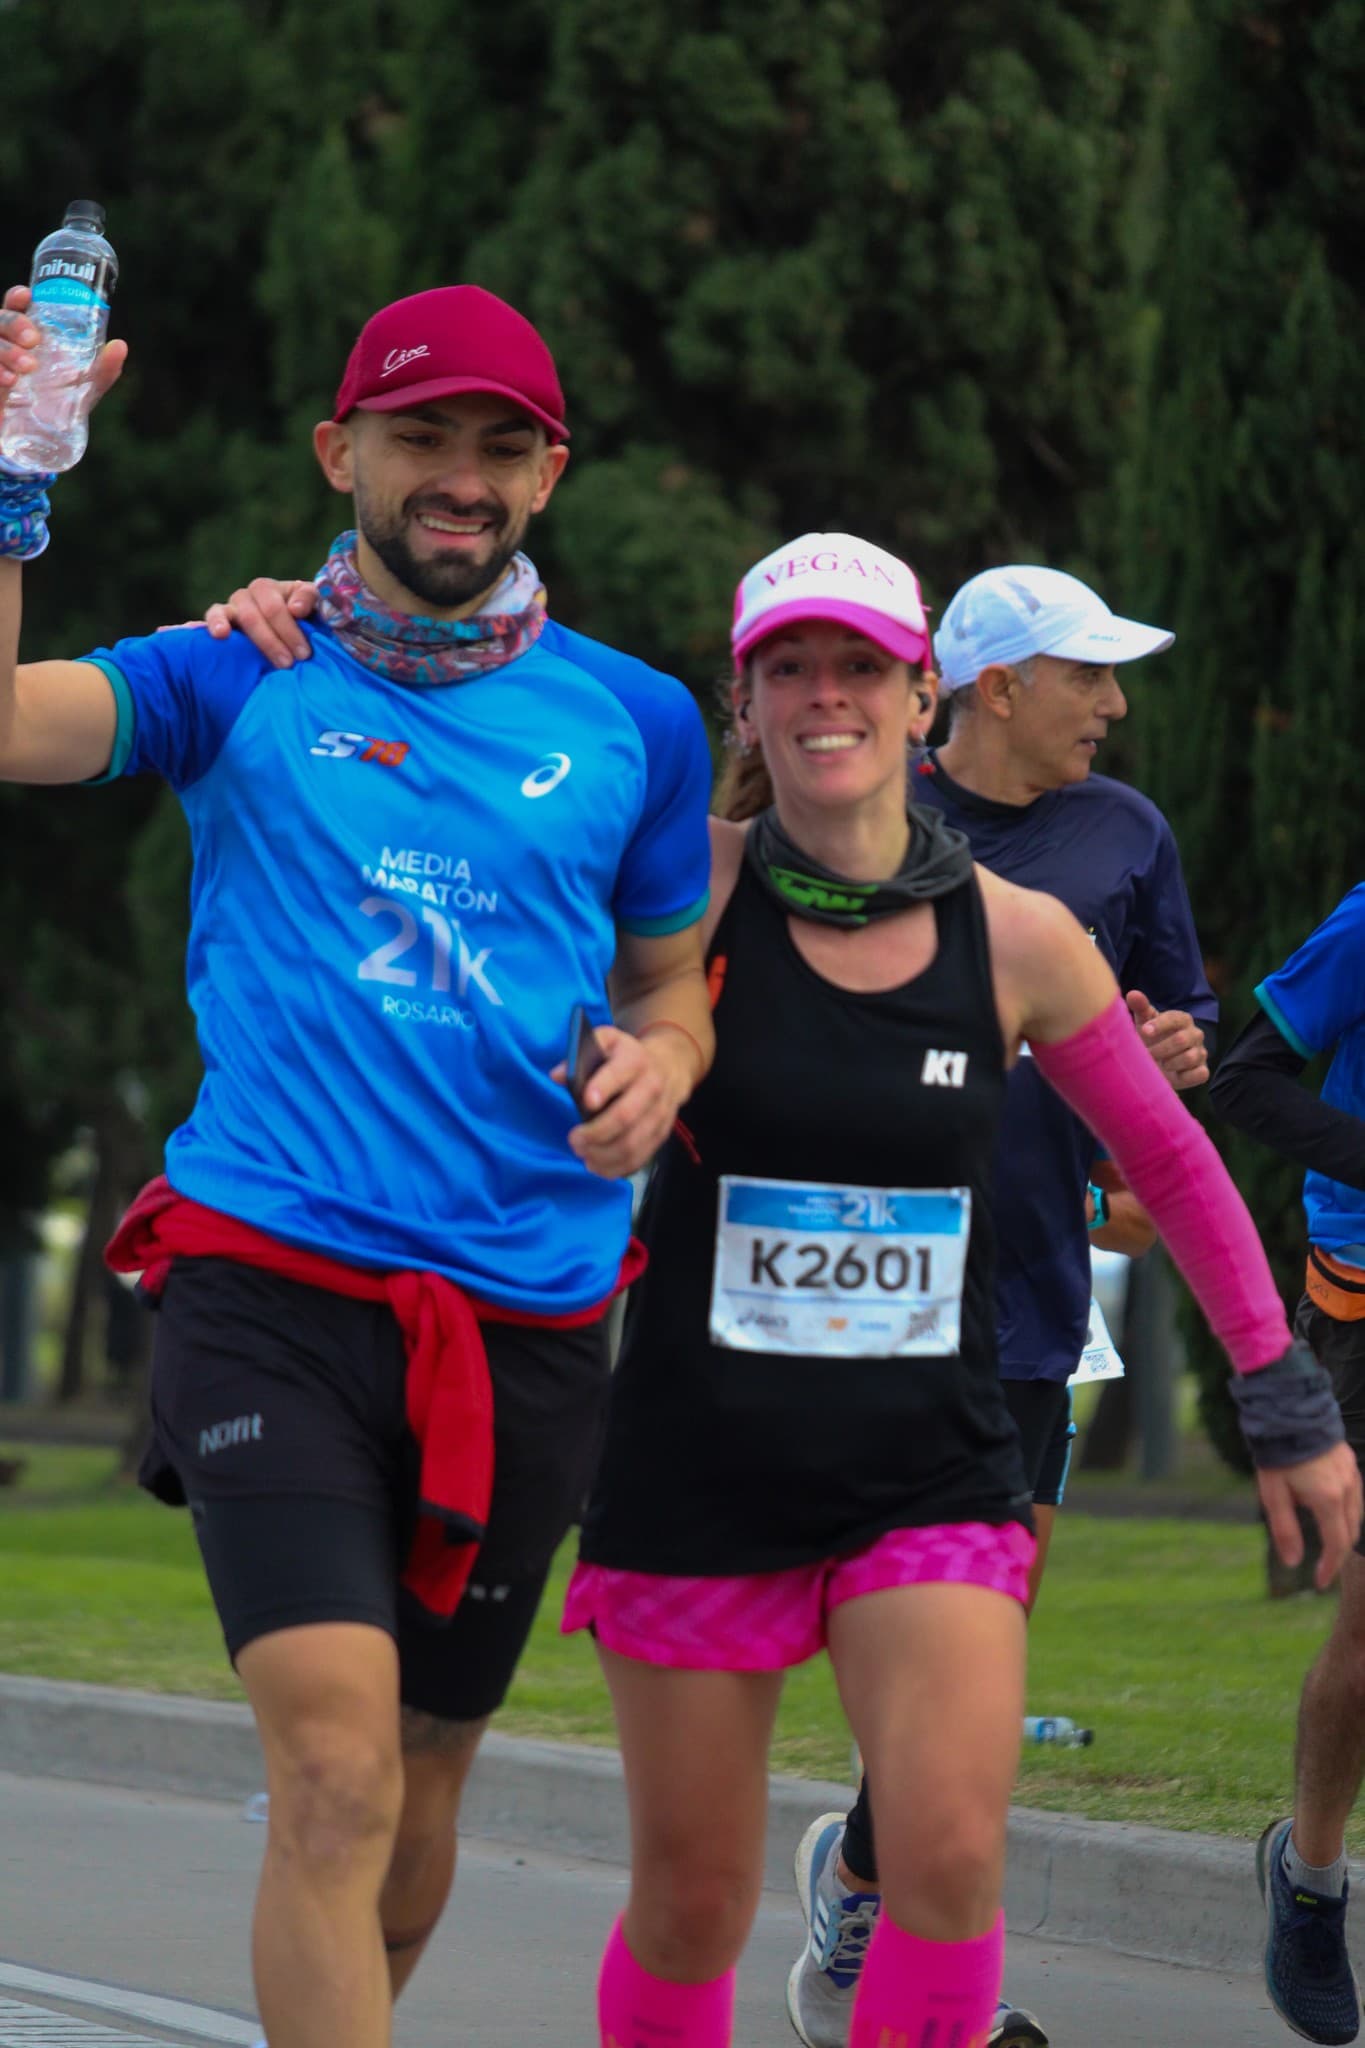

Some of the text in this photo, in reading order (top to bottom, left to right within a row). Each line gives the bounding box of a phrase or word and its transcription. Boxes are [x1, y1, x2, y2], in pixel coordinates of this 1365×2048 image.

[763, 552, 895, 587] VEGAN
[380, 846, 472, 882] MEDIA
[382, 995, 476, 1031] ROSARIO
[751, 1239, 932, 1293] K2601
